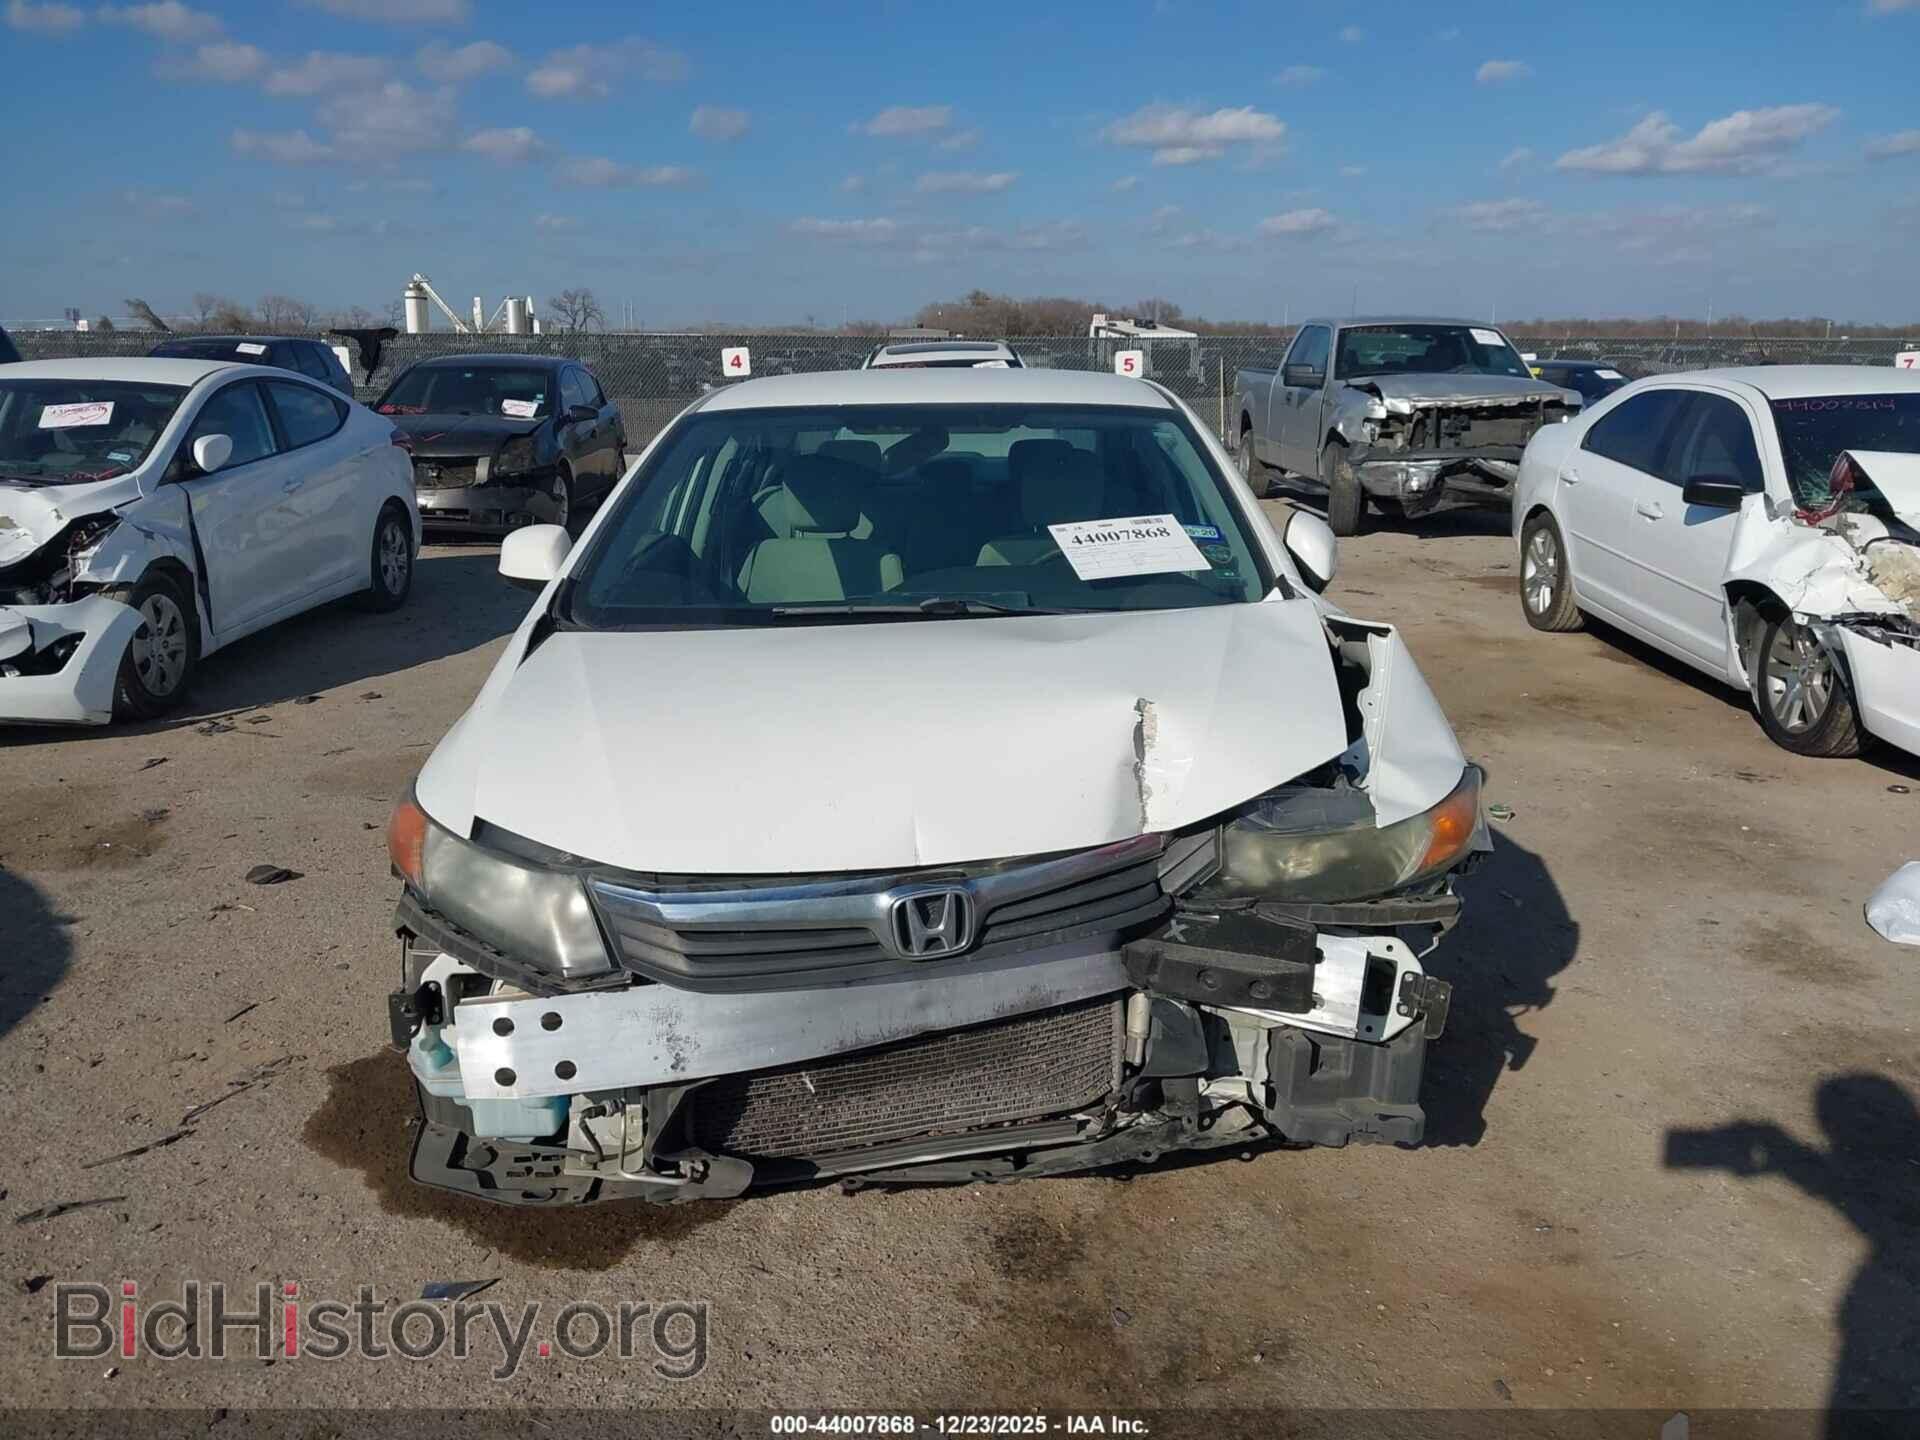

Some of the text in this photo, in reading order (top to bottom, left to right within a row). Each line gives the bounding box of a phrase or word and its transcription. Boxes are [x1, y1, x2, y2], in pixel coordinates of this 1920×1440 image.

[731, 354, 742, 369] 4
[1124, 358, 1135, 372] 5
[1903, 359, 1914, 369] 7
[1071, 526, 1171, 545] 44007868
